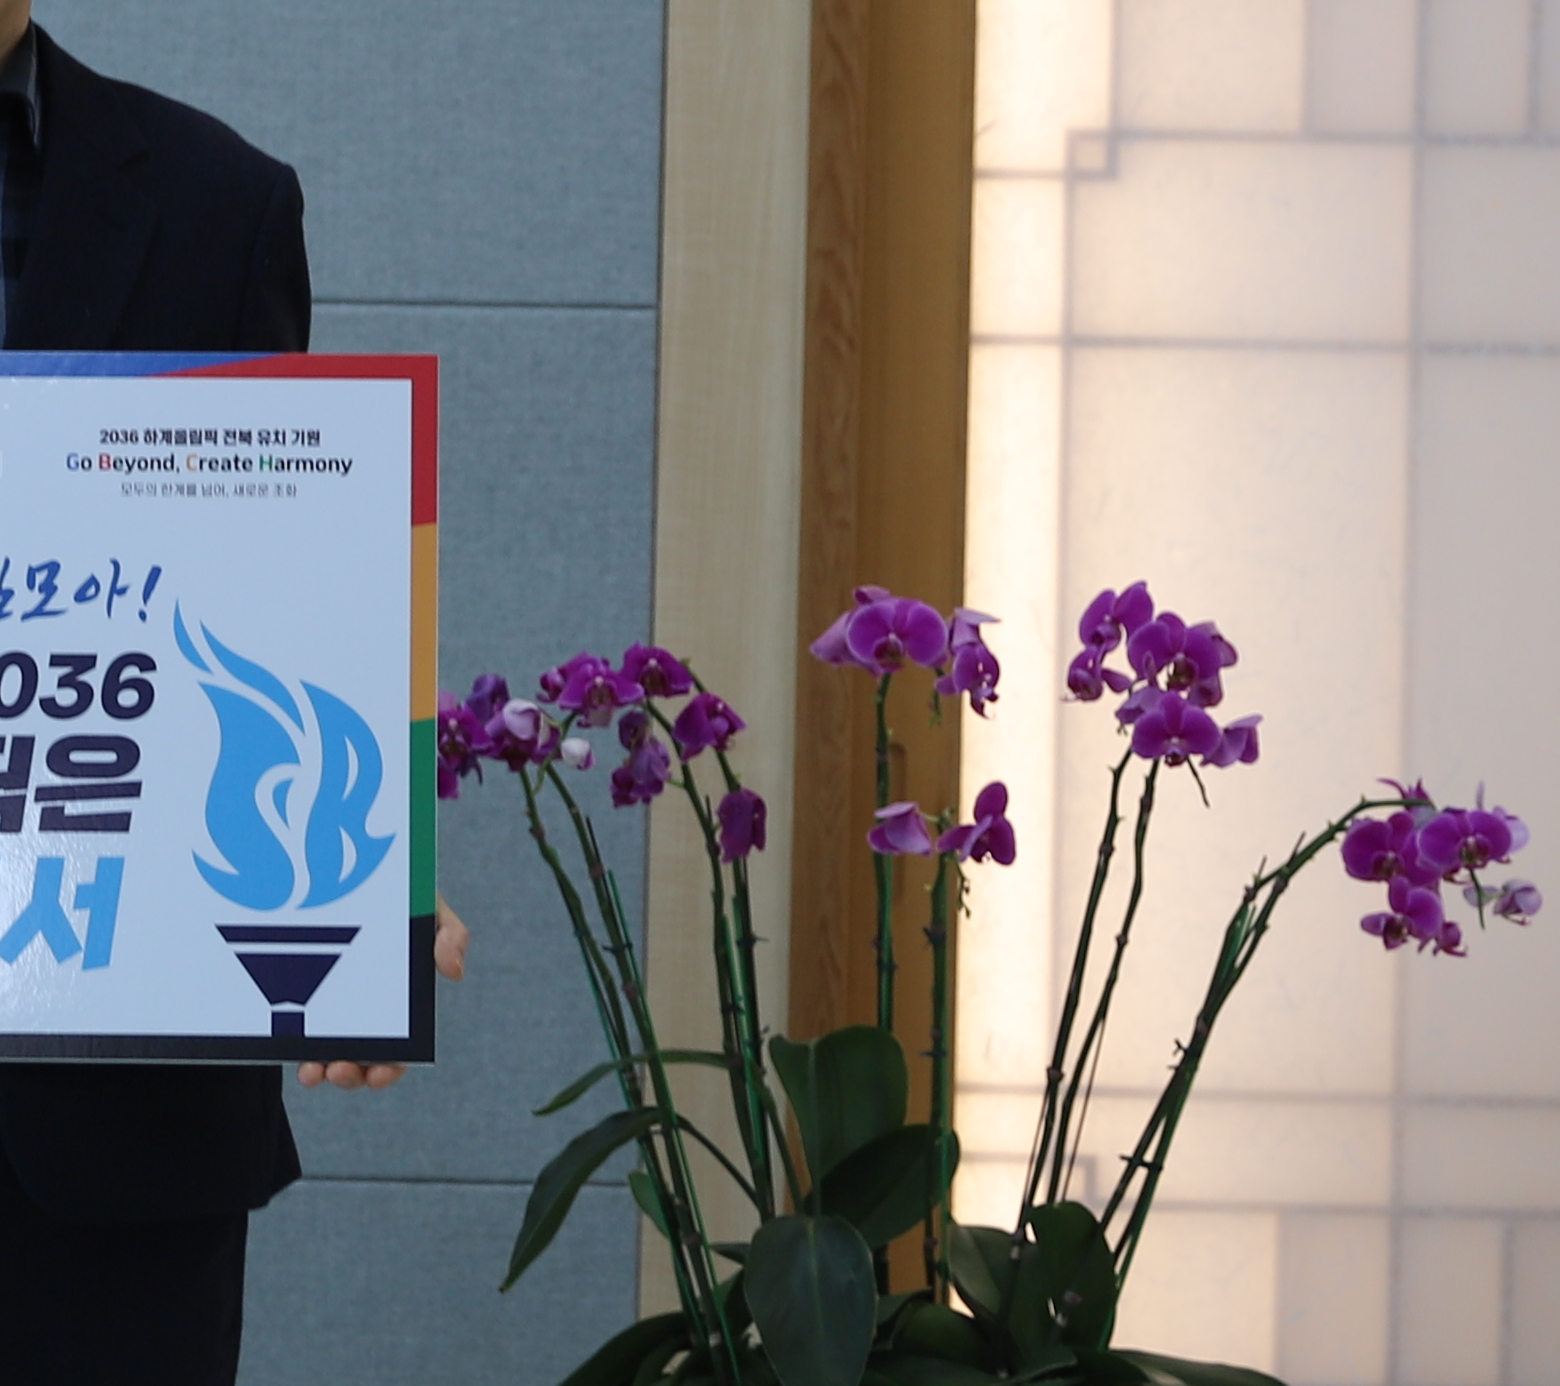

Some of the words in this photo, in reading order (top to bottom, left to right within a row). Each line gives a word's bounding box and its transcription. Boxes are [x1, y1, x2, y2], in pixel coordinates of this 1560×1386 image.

[99, 429, 139, 444] 2036
[143, 428, 218, 447] 하계올림픽
[223, 429, 253, 446] 전북
[257, 429, 287, 447] 유치
[292, 429, 321, 447] 기원
[66, 453, 93, 471] Go
[98, 453, 180, 475] Beyond,
[186, 454, 253, 472] Create
[259, 455, 353, 476] Harmony
